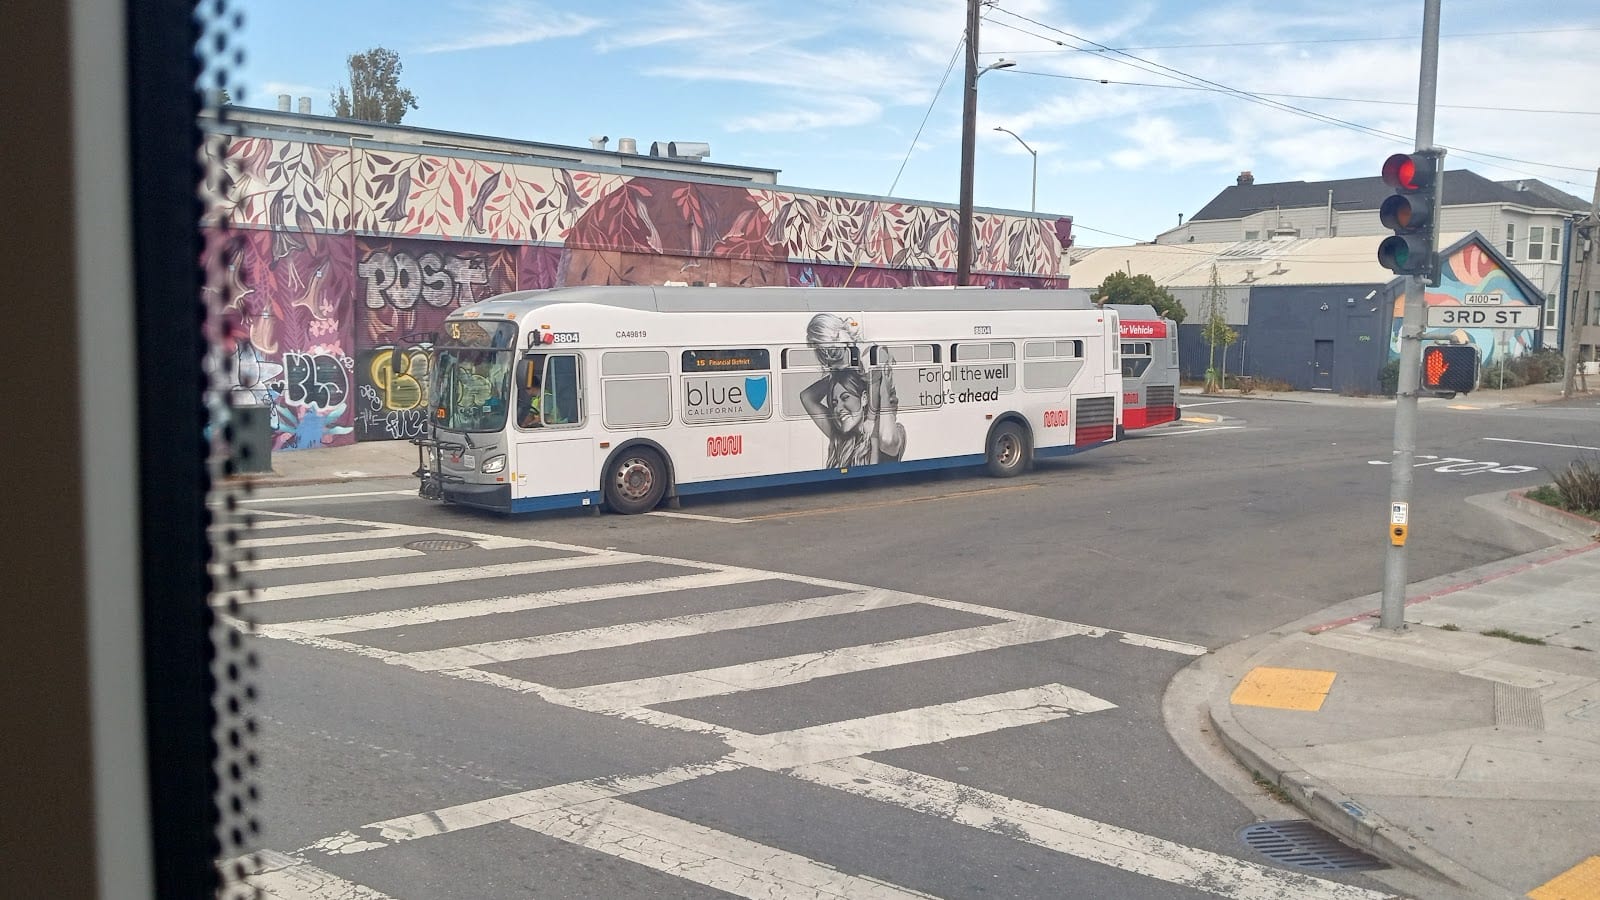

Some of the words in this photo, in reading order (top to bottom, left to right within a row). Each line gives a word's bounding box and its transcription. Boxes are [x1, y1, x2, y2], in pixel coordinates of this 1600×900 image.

[1468, 295, 1489, 304] 4100
[1442, 310, 1486, 324] 3RD
[1495, 310, 1522, 324] ST
[451, 322, 460, 339] 15
[615, 330, 647, 339] CA49819
[1129, 325, 1154, 335] Vehicle
[553, 333, 579, 343] 8804
[696, 359, 706, 367] 15
[708, 358, 731, 366] Financial
[731, 357, 751, 366] District
[918, 368, 940, 384] For
[942, 365, 958, 382] all
[960, 366, 982, 381] the
[984, 363, 1009, 380] well
[686, 380, 742, 407] blue
[918, 388, 956, 407] that's
[958, 386, 999, 404] ahead
[687, 405, 744, 416] CALIFORNIA
